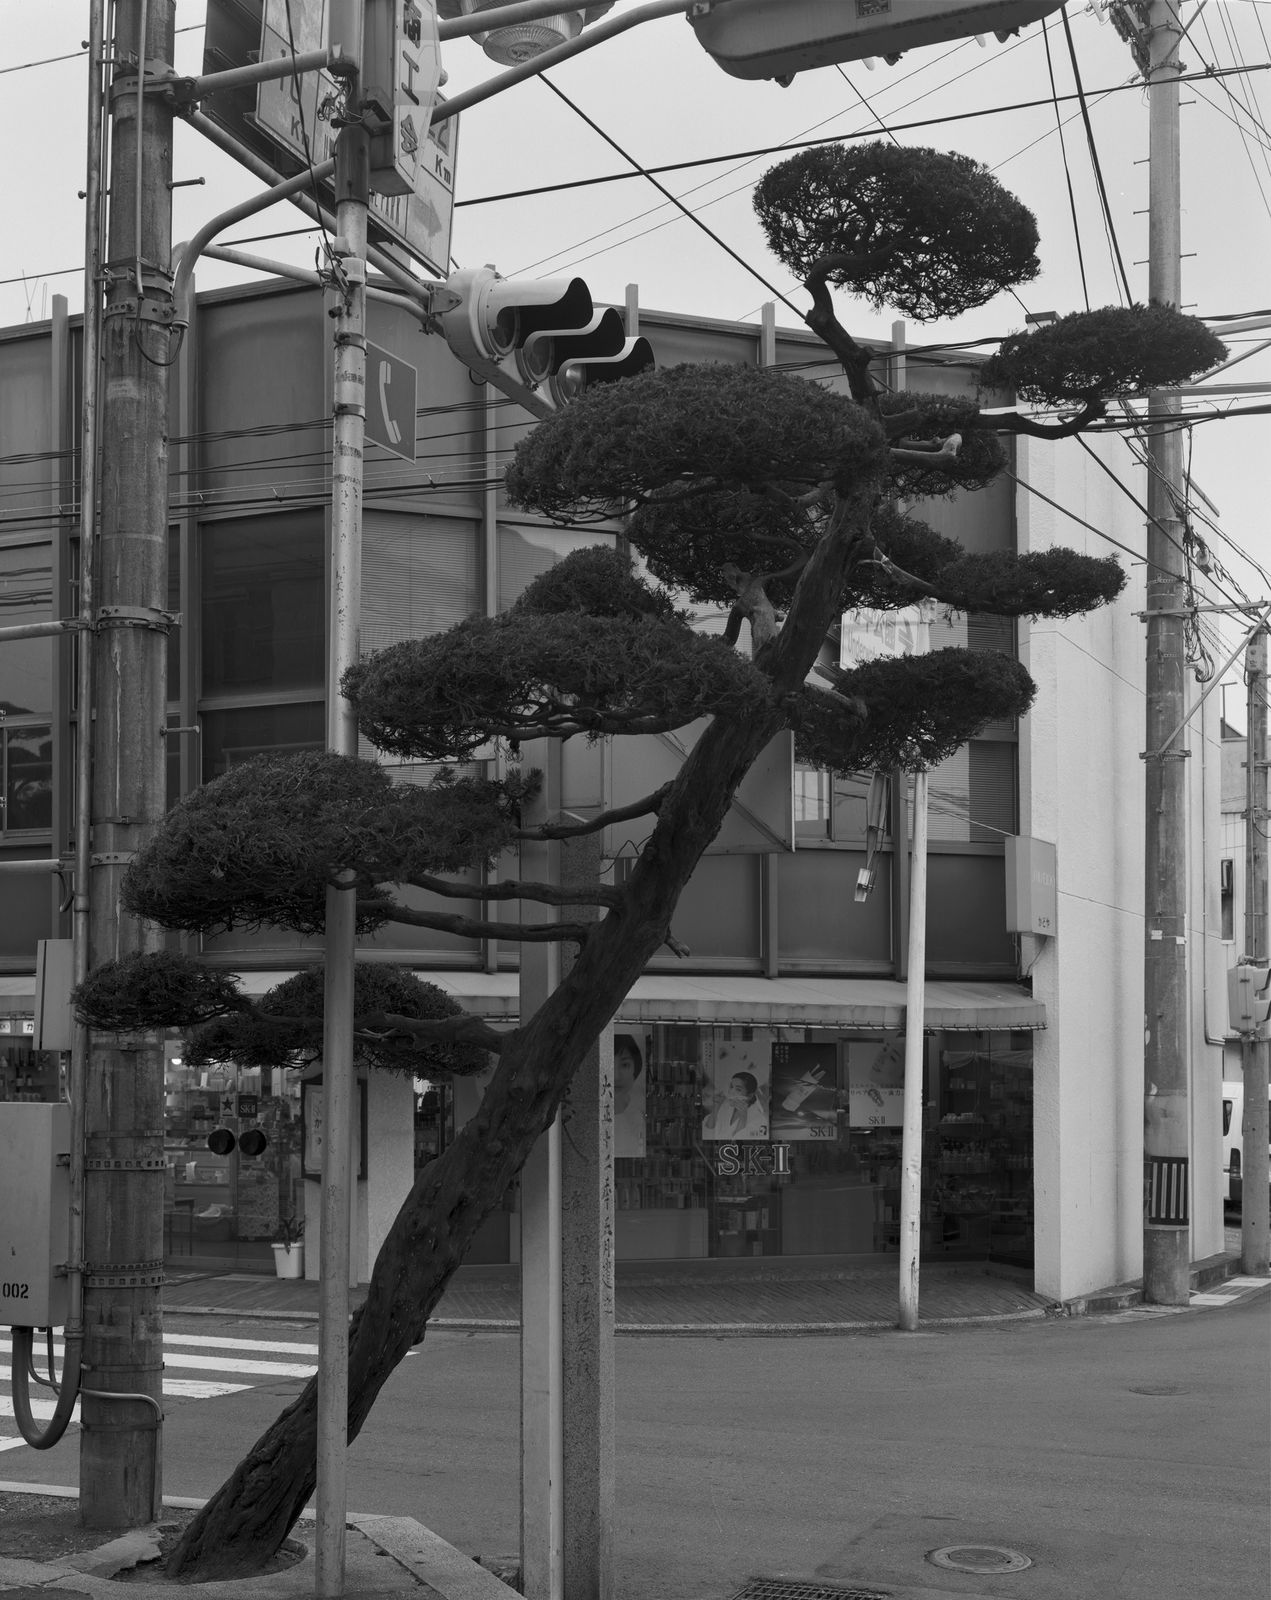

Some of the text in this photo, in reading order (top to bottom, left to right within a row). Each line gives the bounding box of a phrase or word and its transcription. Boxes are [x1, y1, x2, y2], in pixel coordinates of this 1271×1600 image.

[435, 153, 452, 185] Km
[809, 1127, 834, 1138] SK-II
[718, 1144, 791, 1176] SK-II
[2, 1282, 29, 1299] 002
